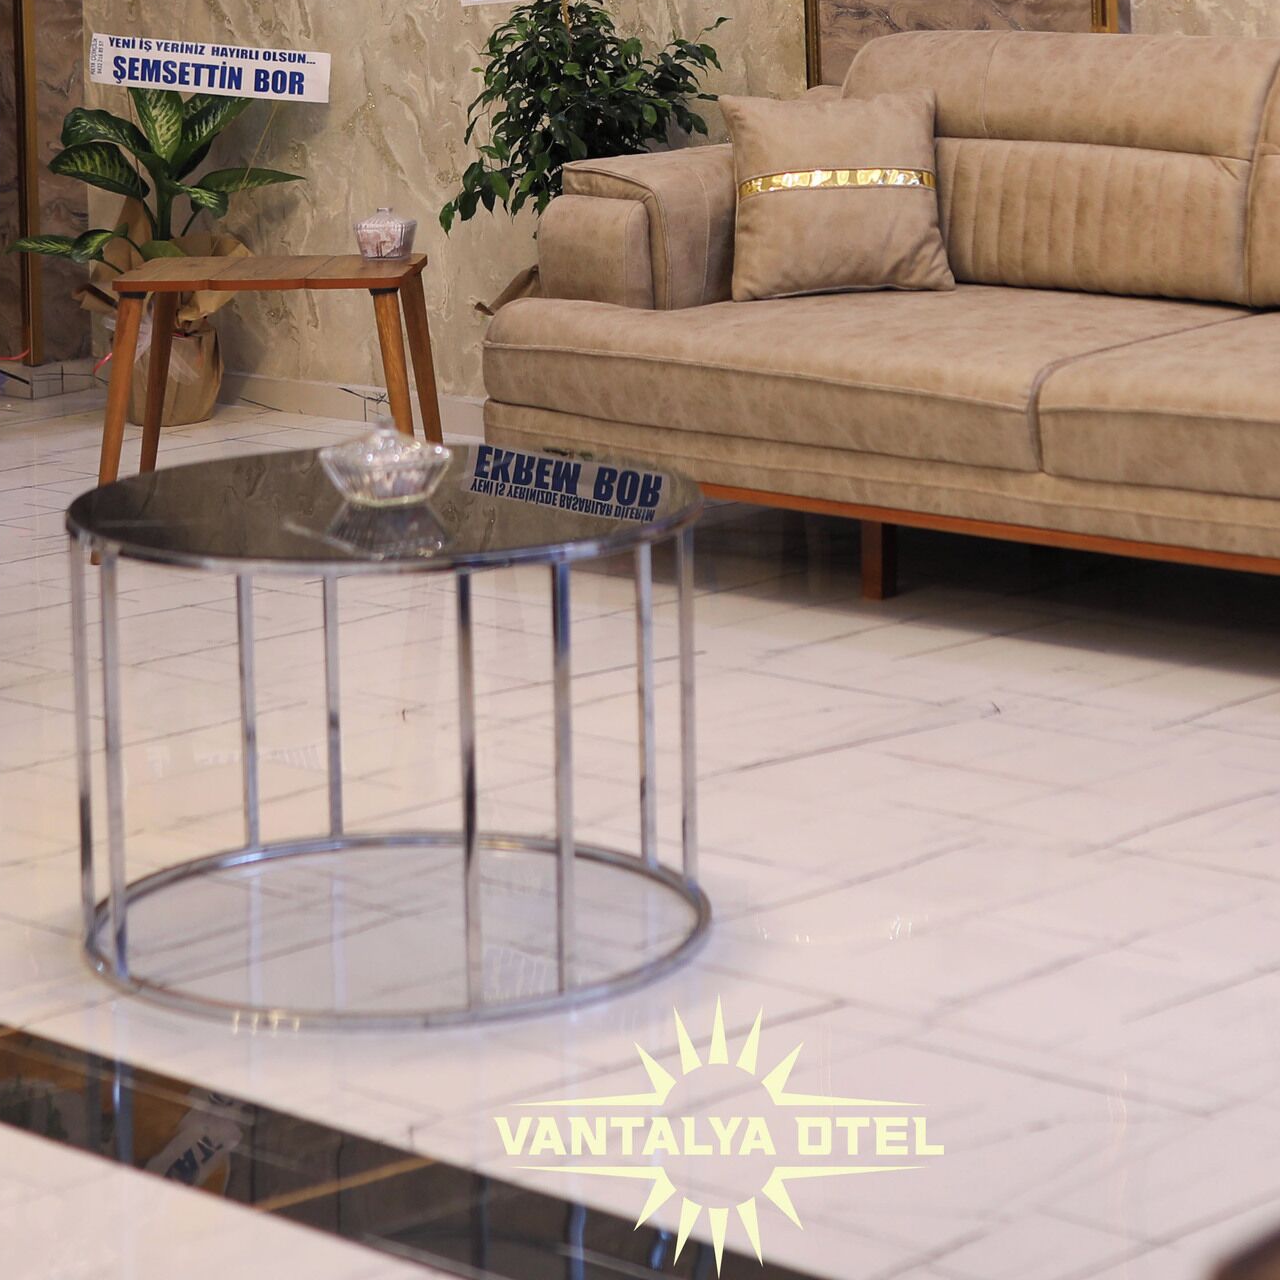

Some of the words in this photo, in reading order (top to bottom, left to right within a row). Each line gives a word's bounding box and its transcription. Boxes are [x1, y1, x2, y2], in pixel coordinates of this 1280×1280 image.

[108, 36, 136, 49] YENİ
[139, 36, 152, 52] İŞ
[155, 41, 206, 56] YERİNİZ
[211, 46, 260, 61] HAYIRLI
[112, 55, 243, 91] ŞEMSETTİN
[253, 68, 306, 96] BOR
